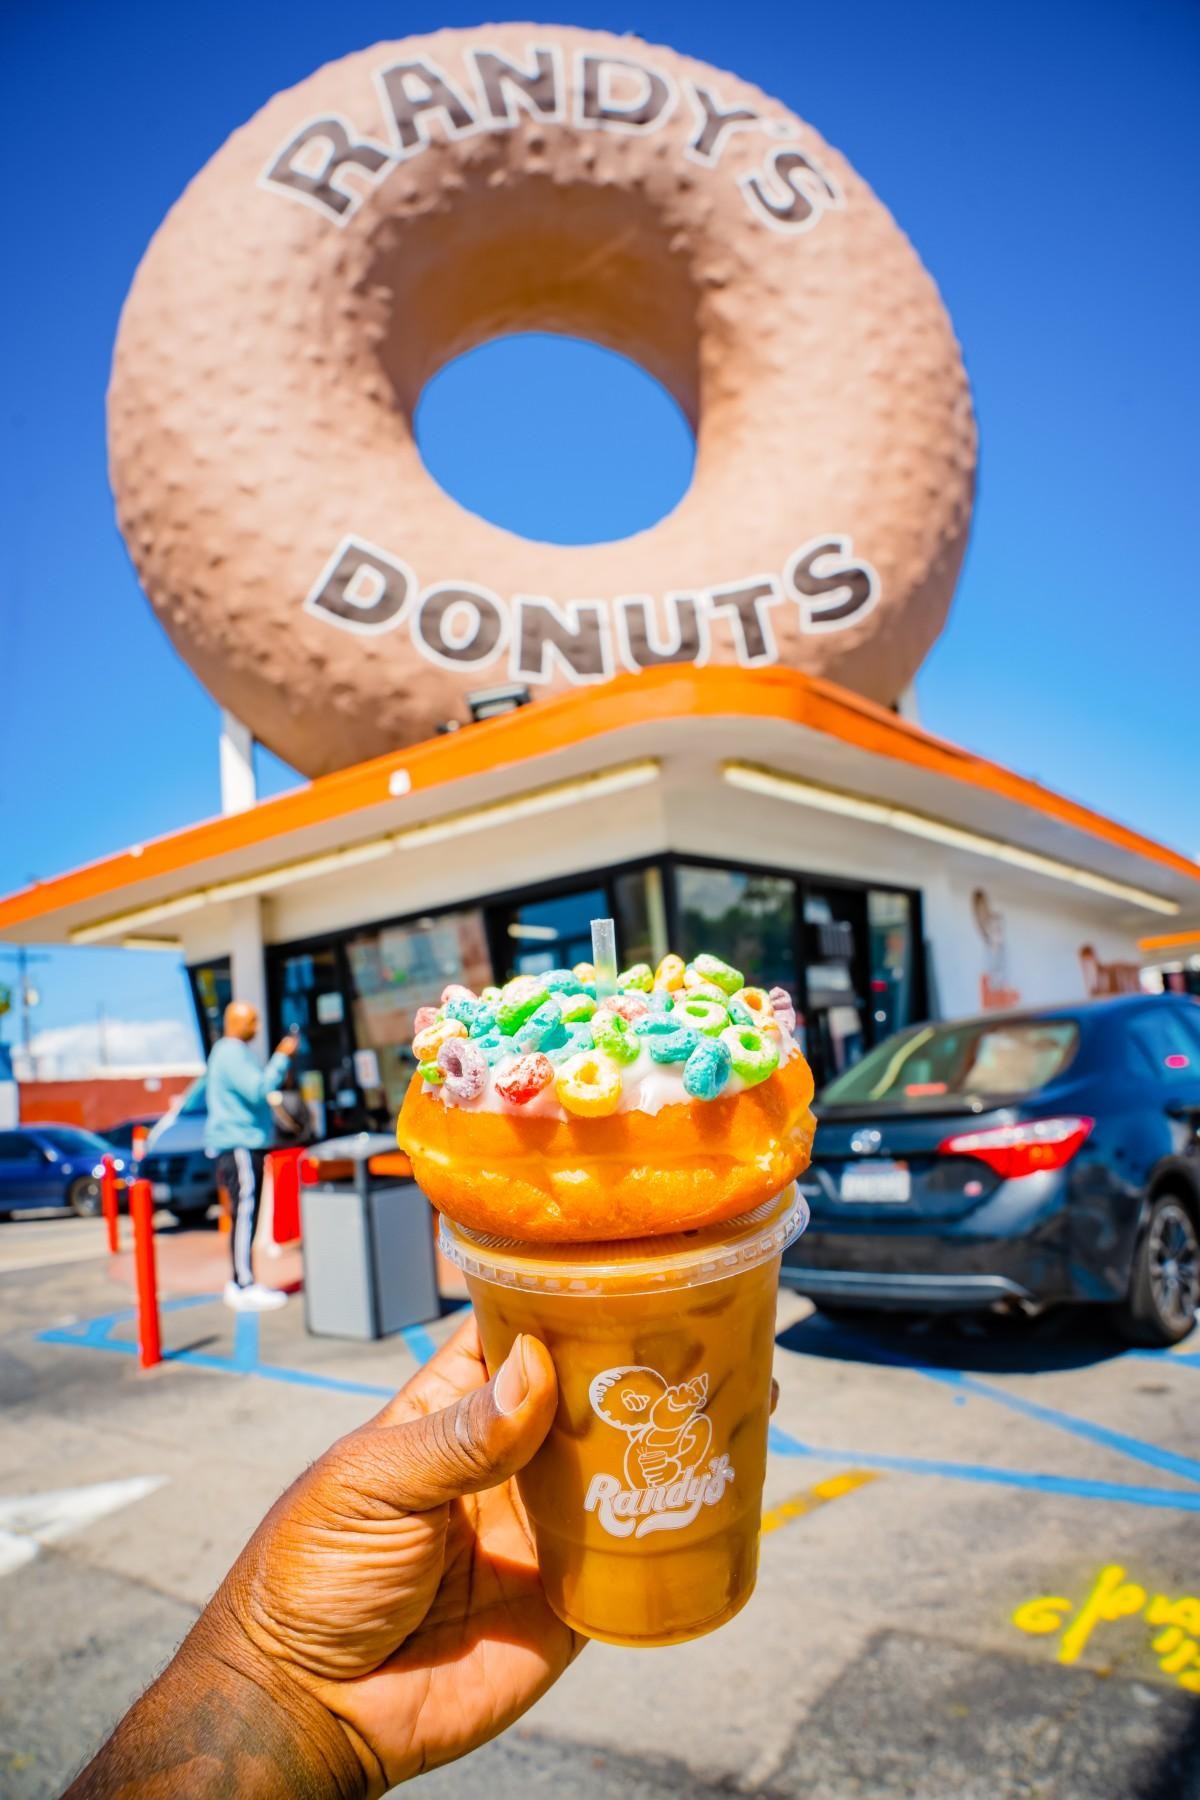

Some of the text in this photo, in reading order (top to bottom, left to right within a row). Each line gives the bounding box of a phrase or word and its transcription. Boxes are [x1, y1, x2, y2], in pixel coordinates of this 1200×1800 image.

[258, 42, 847, 234] RANDY'S
[304, 533, 882, 684] DONUTS
[584, 1453, 735, 1538] Randy's
